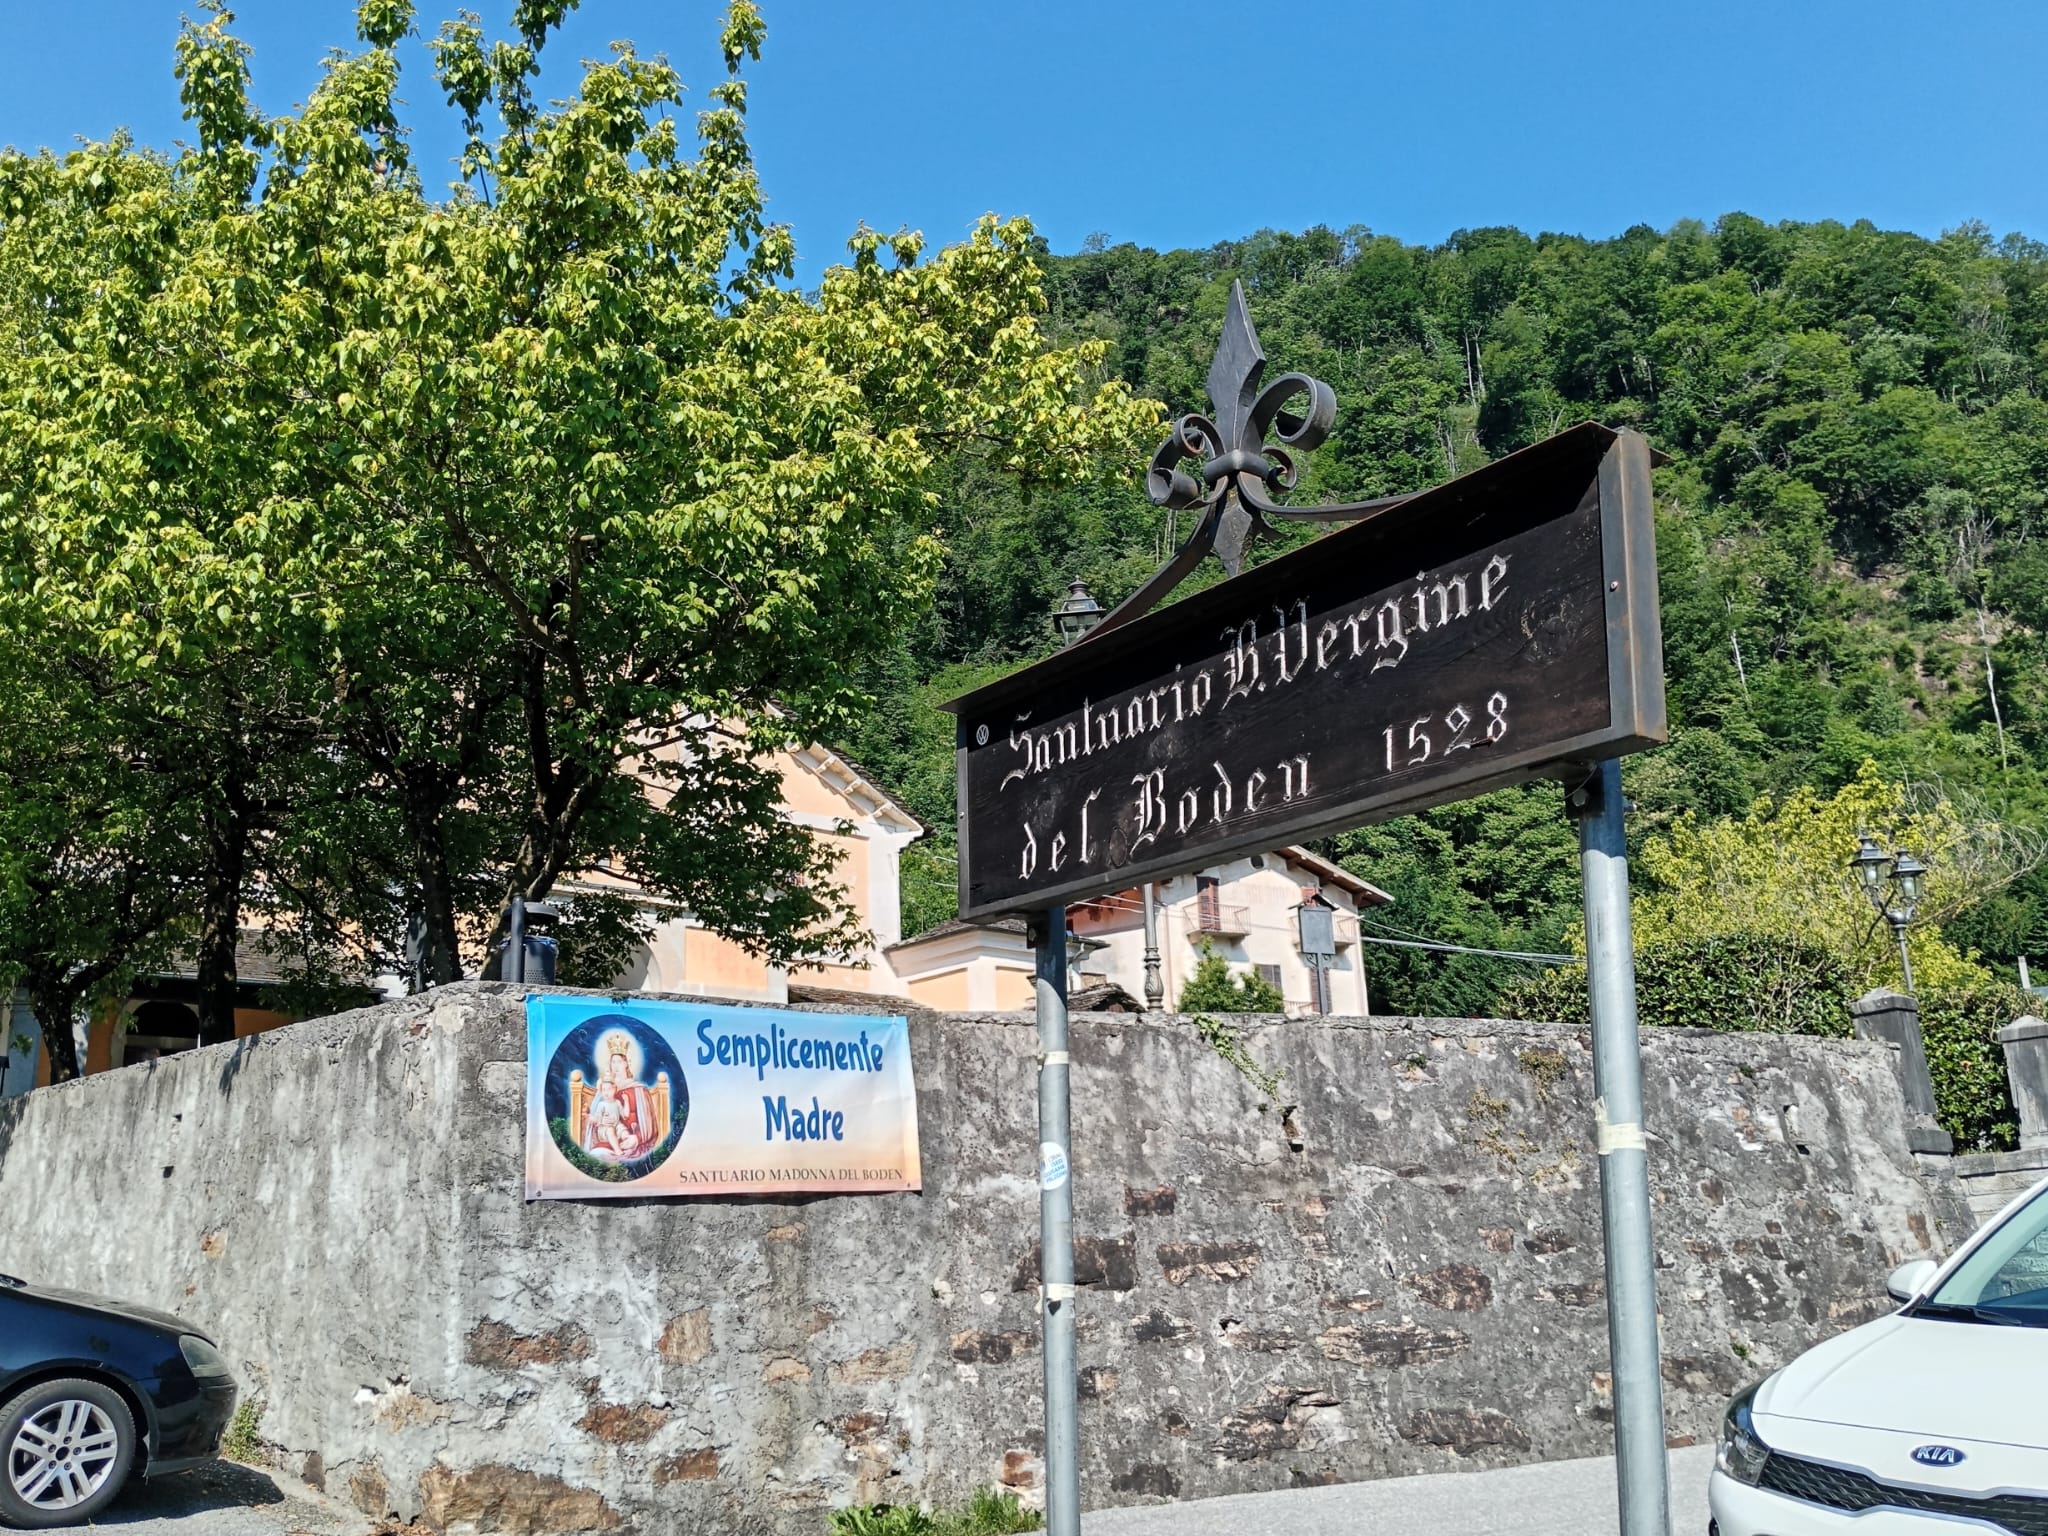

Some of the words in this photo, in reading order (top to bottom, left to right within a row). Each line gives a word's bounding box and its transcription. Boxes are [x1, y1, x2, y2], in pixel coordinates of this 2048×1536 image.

[1000, 663, 1214, 793] Santuario
[1019, 786, 1102, 881] del
[1129, 752, 1315, 857] Boden
[1382, 691, 1508, 772] 1528
[696, 1018, 884, 1081] Semplicemente
[762, 1095, 844, 1142] Madre
[679, 1168, 766, 1183] SANTUARIO
[769, 1168, 836, 1182] MADONNA
[839, 1168, 861, 1181] DEL
[863, 1168, 903, 1181] BODEN
[1916, 1446, 1955, 1464] KIA
